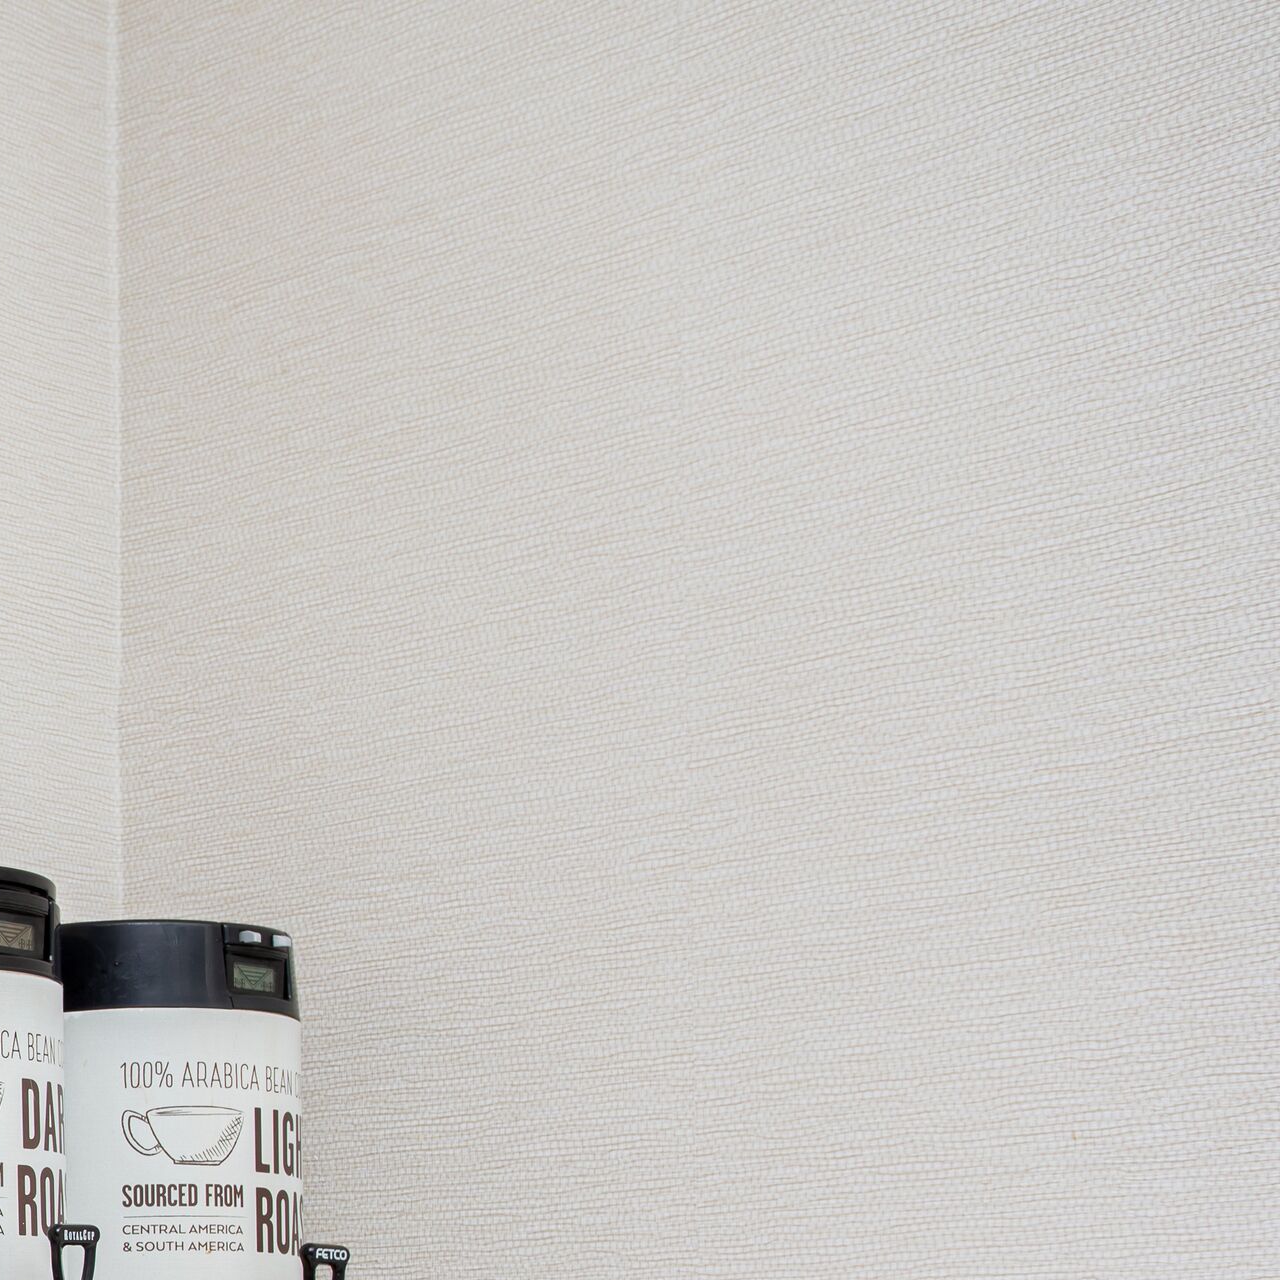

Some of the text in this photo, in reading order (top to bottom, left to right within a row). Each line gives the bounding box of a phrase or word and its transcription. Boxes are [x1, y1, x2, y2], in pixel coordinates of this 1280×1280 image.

[27, 1032, 56, 1065] BEAN
[120, 1061, 173, 1089] 100%
[182, 1061, 260, 1091] ARABICA
[265, 1065, 293, 1097] BEAN
[17, 1163, 67, 1237] ROA
[122, 1183, 244, 1208] SOURCED FROM
[122, 1224, 244, 1235] CENTRAL AMERICA
[123, 1241, 245, 1252] & SOUTH AMERICA
[316, 1247, 348, 1261] FETCO
